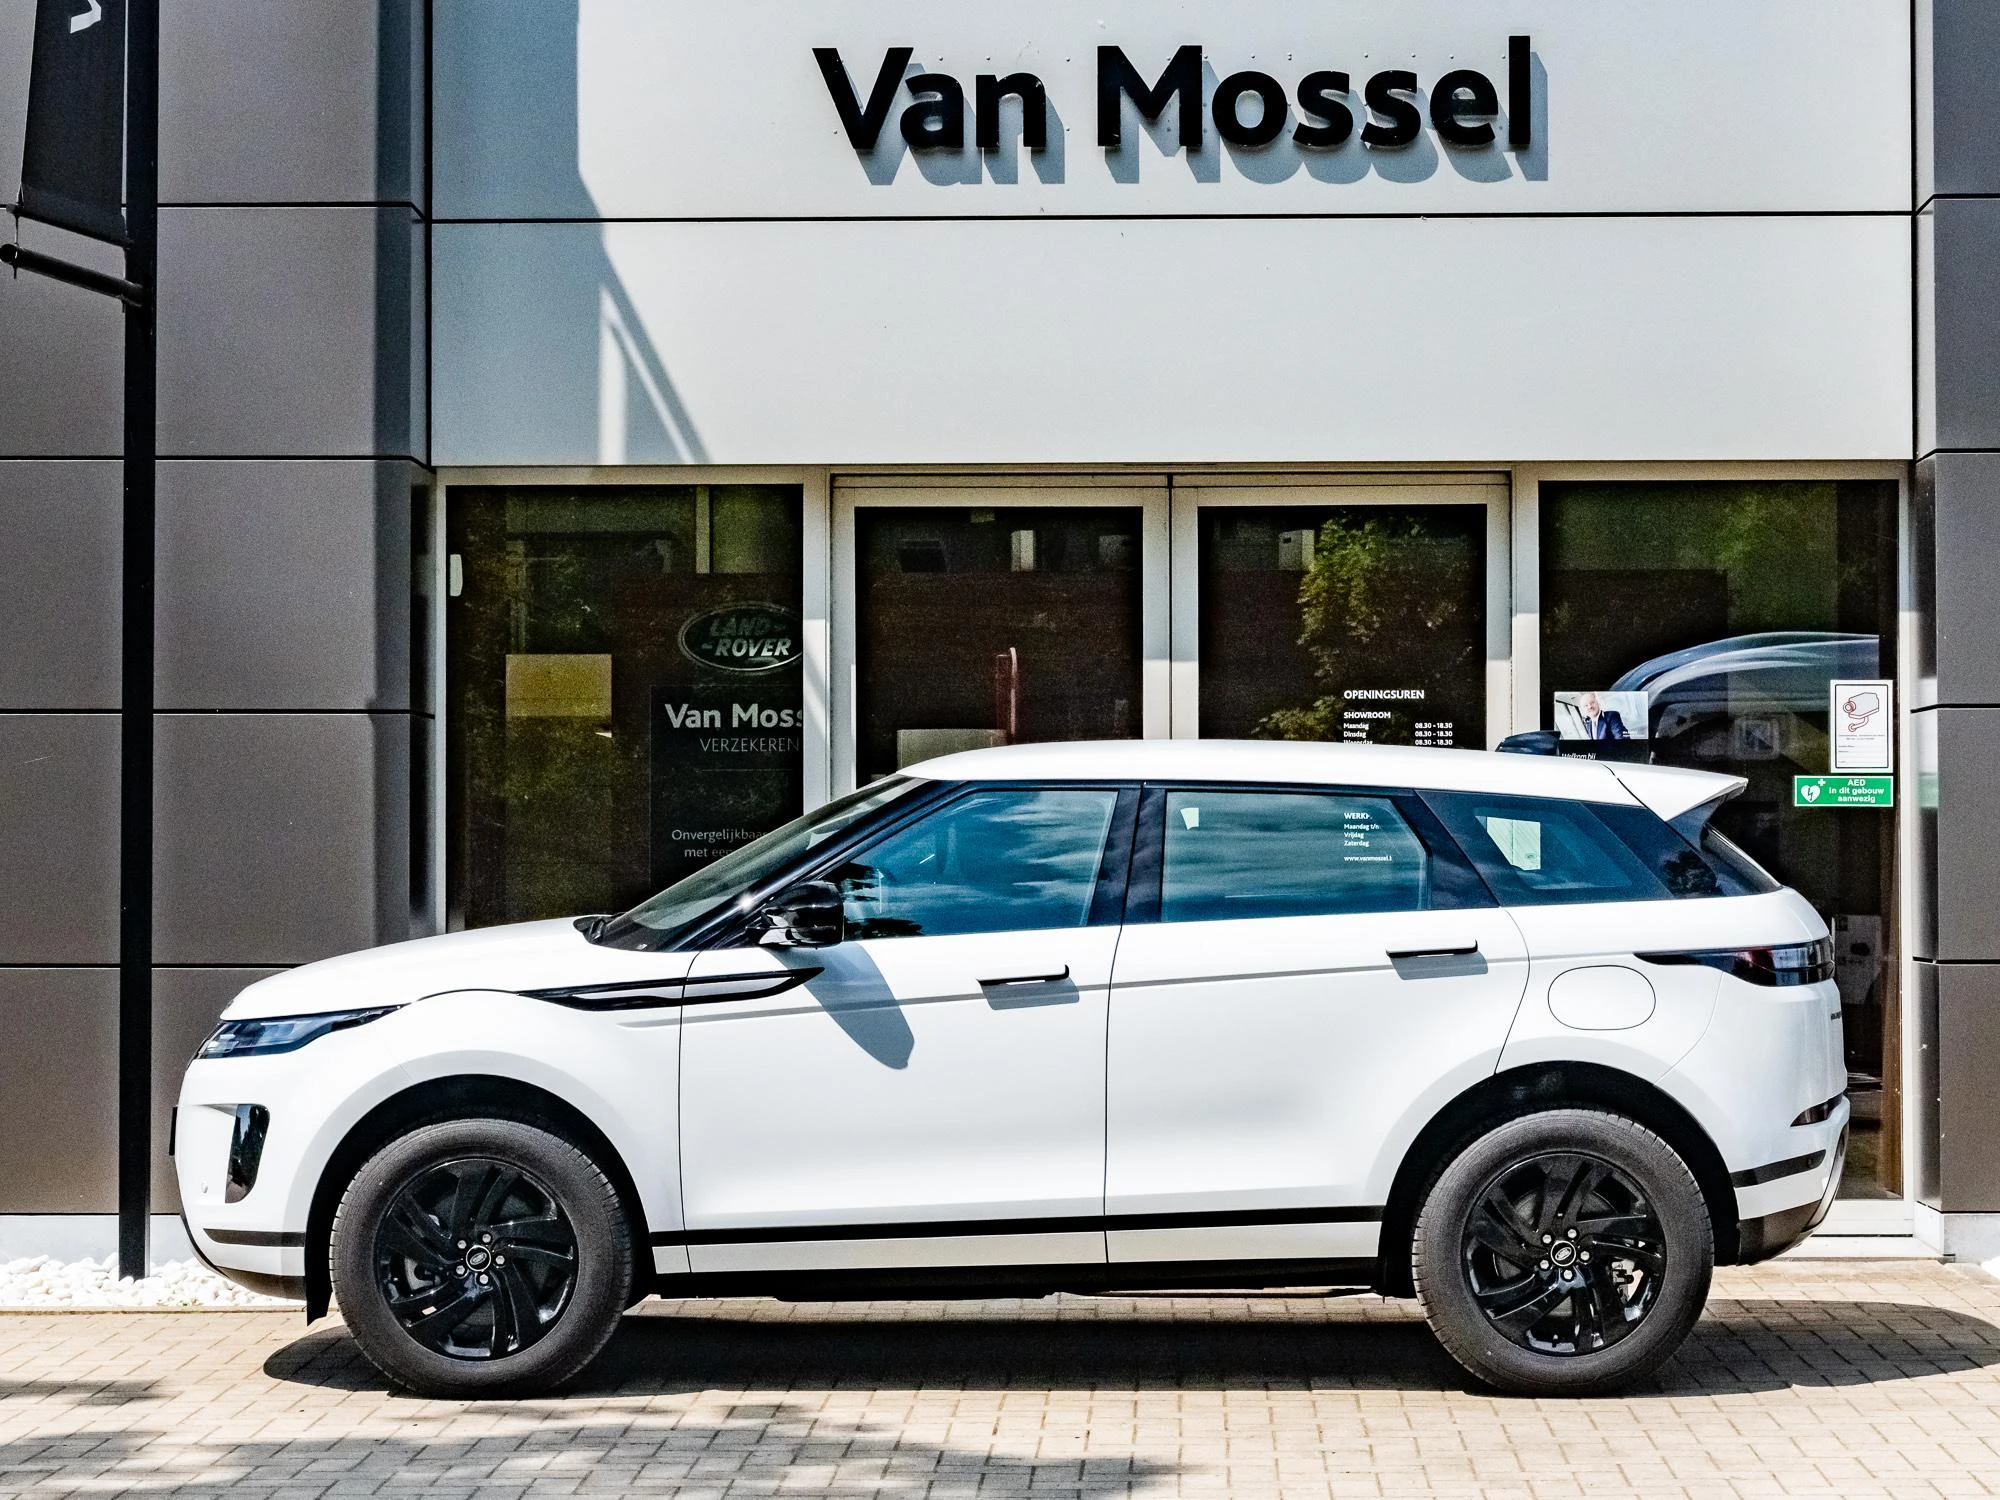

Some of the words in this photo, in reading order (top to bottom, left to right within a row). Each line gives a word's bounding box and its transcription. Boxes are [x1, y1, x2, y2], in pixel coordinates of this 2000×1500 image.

[812, 46, 1047, 149] Van
[1097, 35, 1531, 148] Mossel
[710, 617, 771, 637] LAND
[714, 638, 792, 657] ROVER
[1343, 689, 1425, 700] OPENINGSUREN
[664, 702, 721, 729] Van
[1343, 711, 1391, 719] SHOWROOM
[1343, 722, 1370, 731] Maandag
[1343, 731, 1367, 739] Dinsdag
[700, 738, 799, 752] VERZEKEREN
[1847, 778, 1866, 787] AED
[1839, 786, 1850, 794] dit
[1852, 787, 1885, 796] gebouw
[1837, 795, 1876, 804] aanwezig
[1343, 823, 1370, 831] Maandag
[1343, 831, 1365, 840] Vrijdag
[1343, 840, 1370, 848] Zaterdag
[683, 847, 708, 857] met
